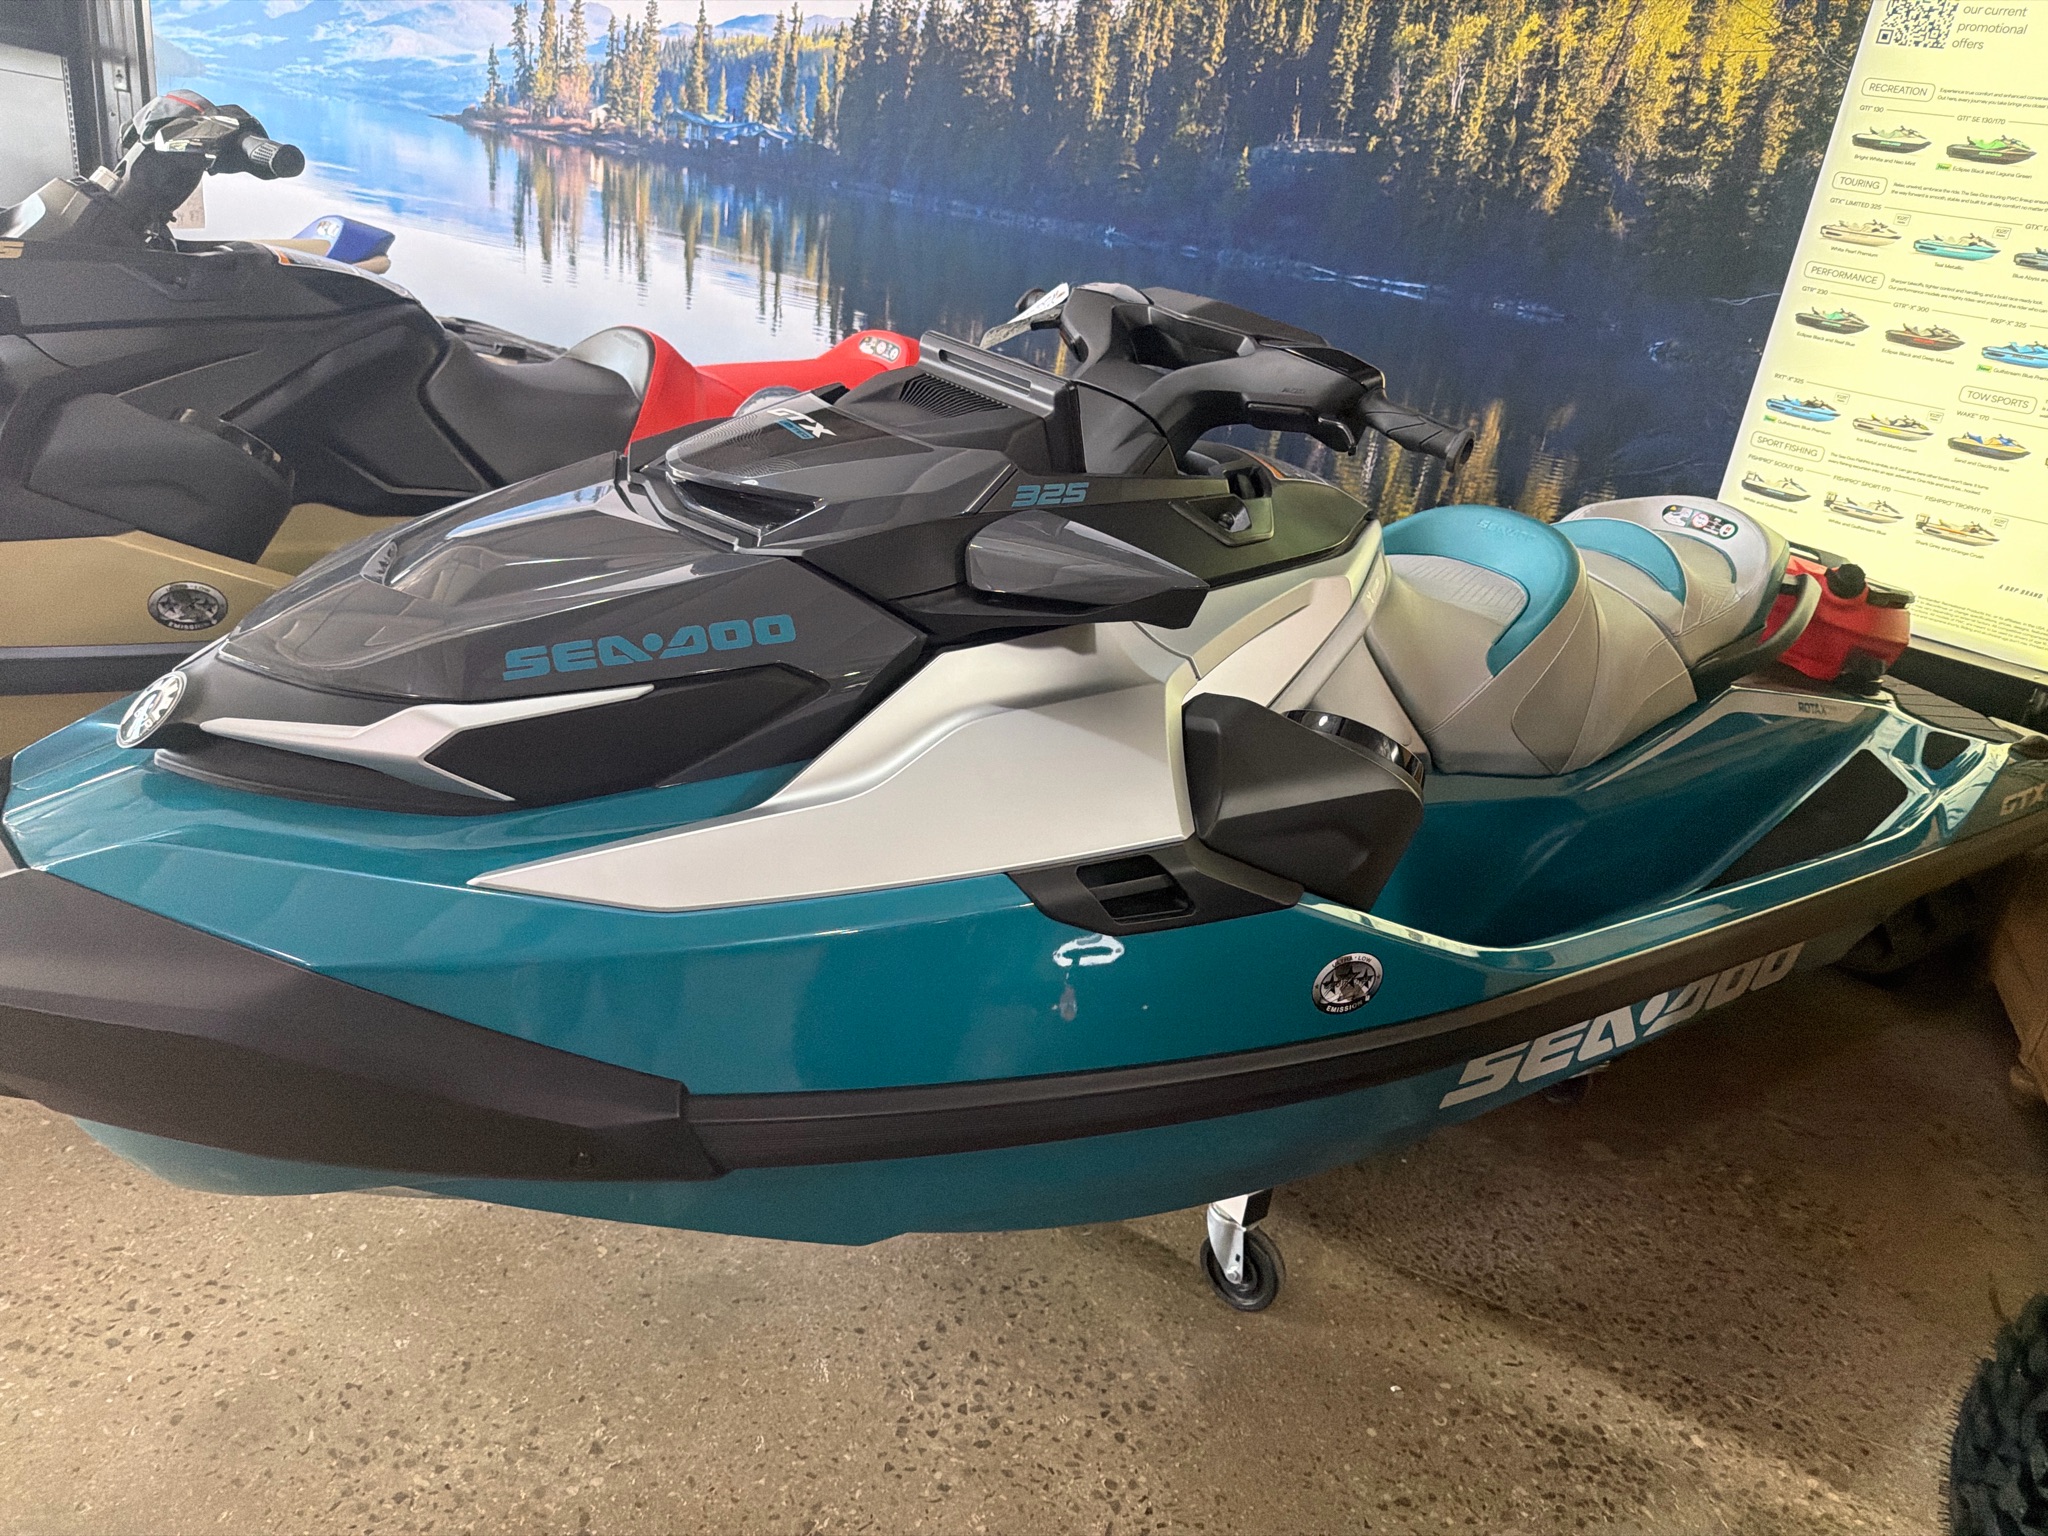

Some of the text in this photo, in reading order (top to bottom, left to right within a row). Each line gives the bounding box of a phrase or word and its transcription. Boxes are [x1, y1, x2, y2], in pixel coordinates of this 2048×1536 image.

[1963, 6, 2028, 17] our current
[1956, 23, 2028, 35] promotional
[1952, 38, 1984, 50] offers
[1869, 82, 1928, 96] RECREATION
[1981, 117, 2006, 125] 130/170
[1840, 176, 1880, 189] TOURING
[1845, 200, 1870, 208] LIMITED
[1810, 266, 1878, 285] PERFORMANCE
[1968, 390, 1991, 401] TOW
[1990, 395, 2030, 409] SPORTS
[767, 408, 838, 438] GTX
[1757, 436, 1818, 457] SPORT FISHING
[1774, 460, 1794, 469] SCOUT
[1861, 481, 1881, 490] SPORT
[1011, 482, 1089, 508] 325
[1955, 502, 1981, 512] TROPHY
[1797, 701, 1828, 716] ROTAX
[1357, 955, 1373, 963] LOW
[1325, 1000, 1363, 1014] EMISSION
